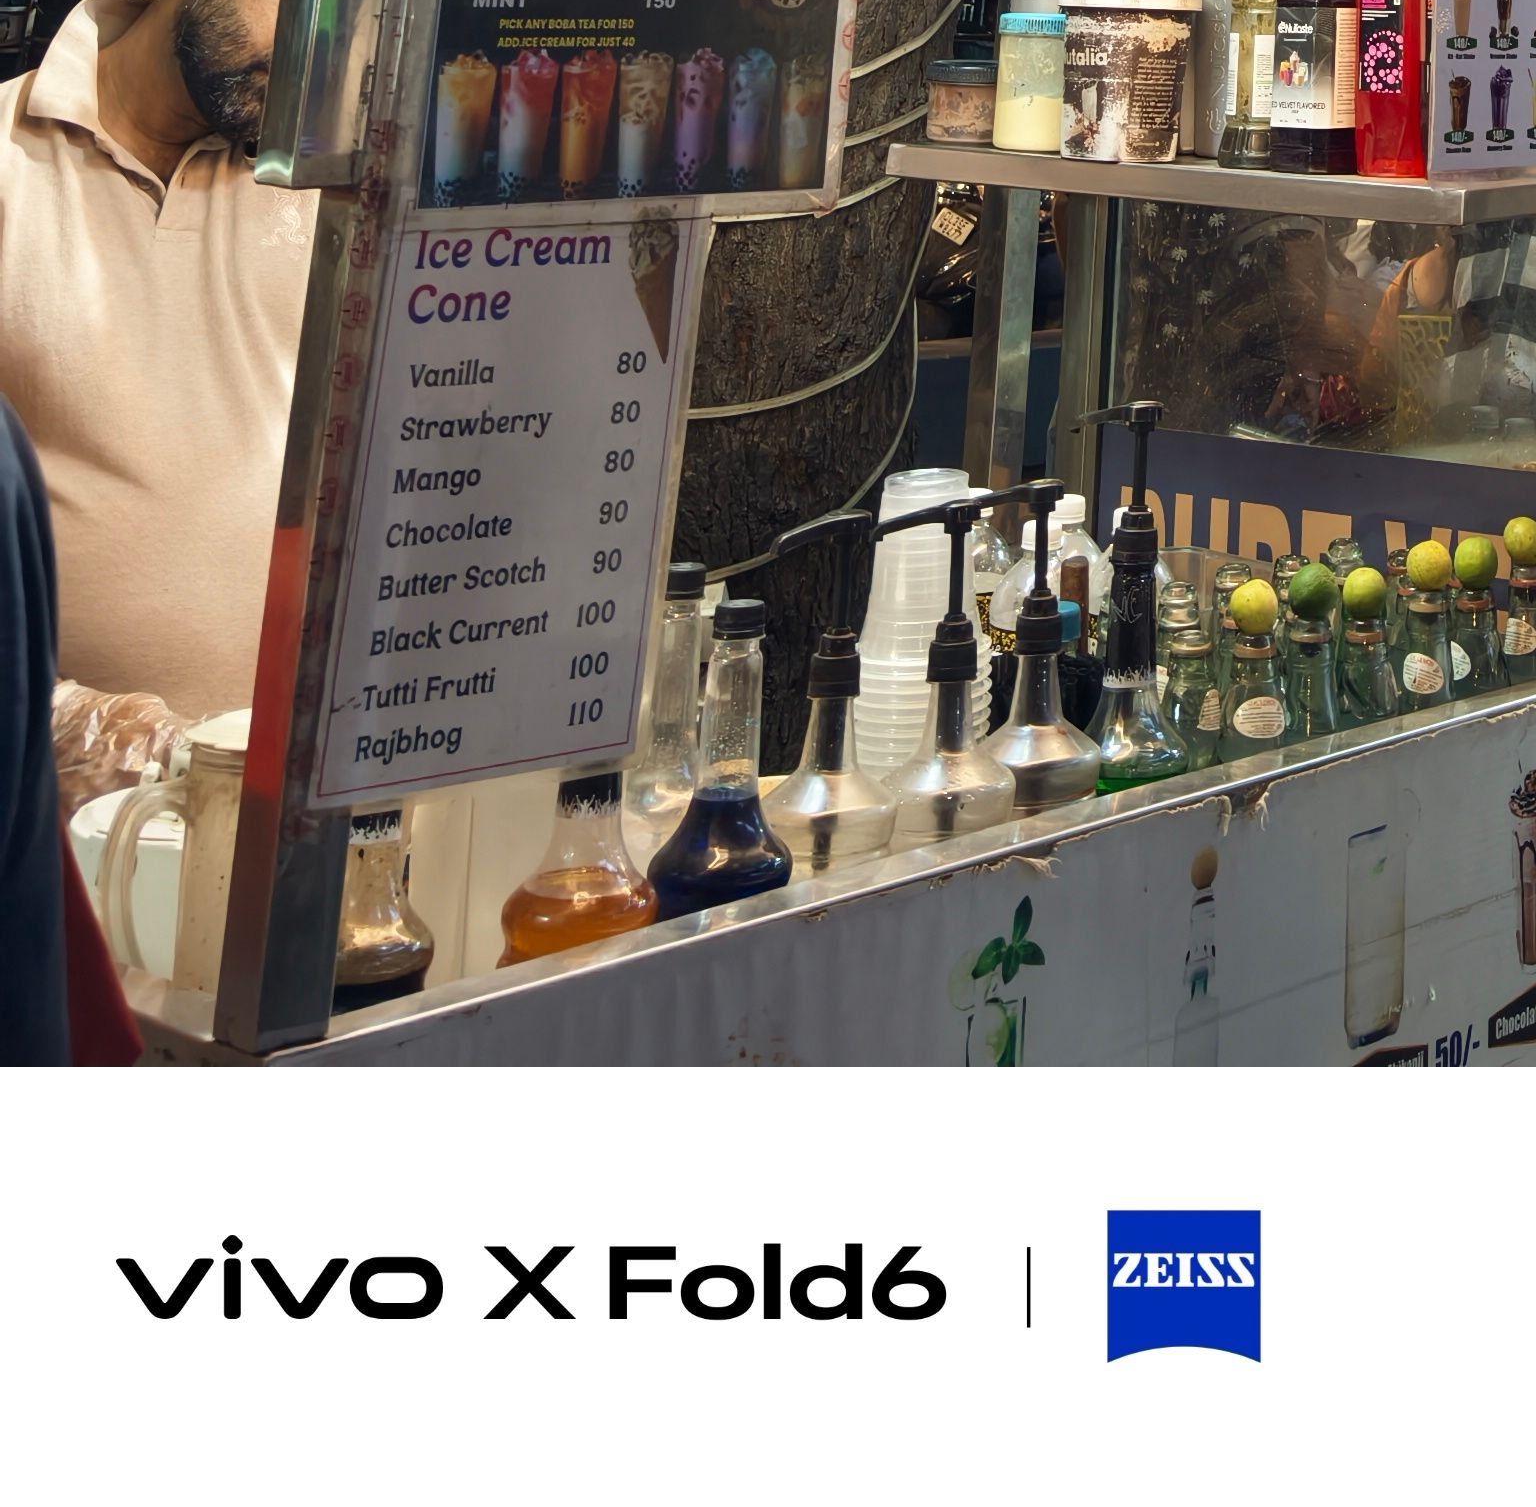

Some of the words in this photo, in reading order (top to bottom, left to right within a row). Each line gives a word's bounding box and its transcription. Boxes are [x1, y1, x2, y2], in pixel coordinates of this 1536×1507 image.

[499, 18, 524, 29] PICK
[524, 18, 547, 29] ANY
[578, 18, 596, 29] TEA
[598, 18, 617, 29] FOR
[414, 230, 473, 270] Ice
[484, 228, 612, 268] Cream
[407, 283, 512, 325] Cone
[409, 358, 495, 389] Vanilla
[616, 350, 647, 375] 80
[400, 408, 553, 442] Strawberry
[610, 400, 641, 424] 80
[392, 467, 482, 497] Mango
[603, 449, 635, 473] 80
[385, 513, 513, 549] Chocolate
[598, 499, 629, 525] 90
[377, 571, 457, 601] Butter
[464, 556, 547, 591] Scotch
[592, 548, 622, 574] 90
[370, 616, 442, 657] Black
[448, 609, 549, 646] Current
[576, 599, 616, 627] 100
[361, 679, 419, 713] Tutti
[425, 667, 496, 704] Frutti
[569, 651, 609, 679] 100
[354, 723, 463, 764] Rajbhog
[567, 698, 603, 726] 110
